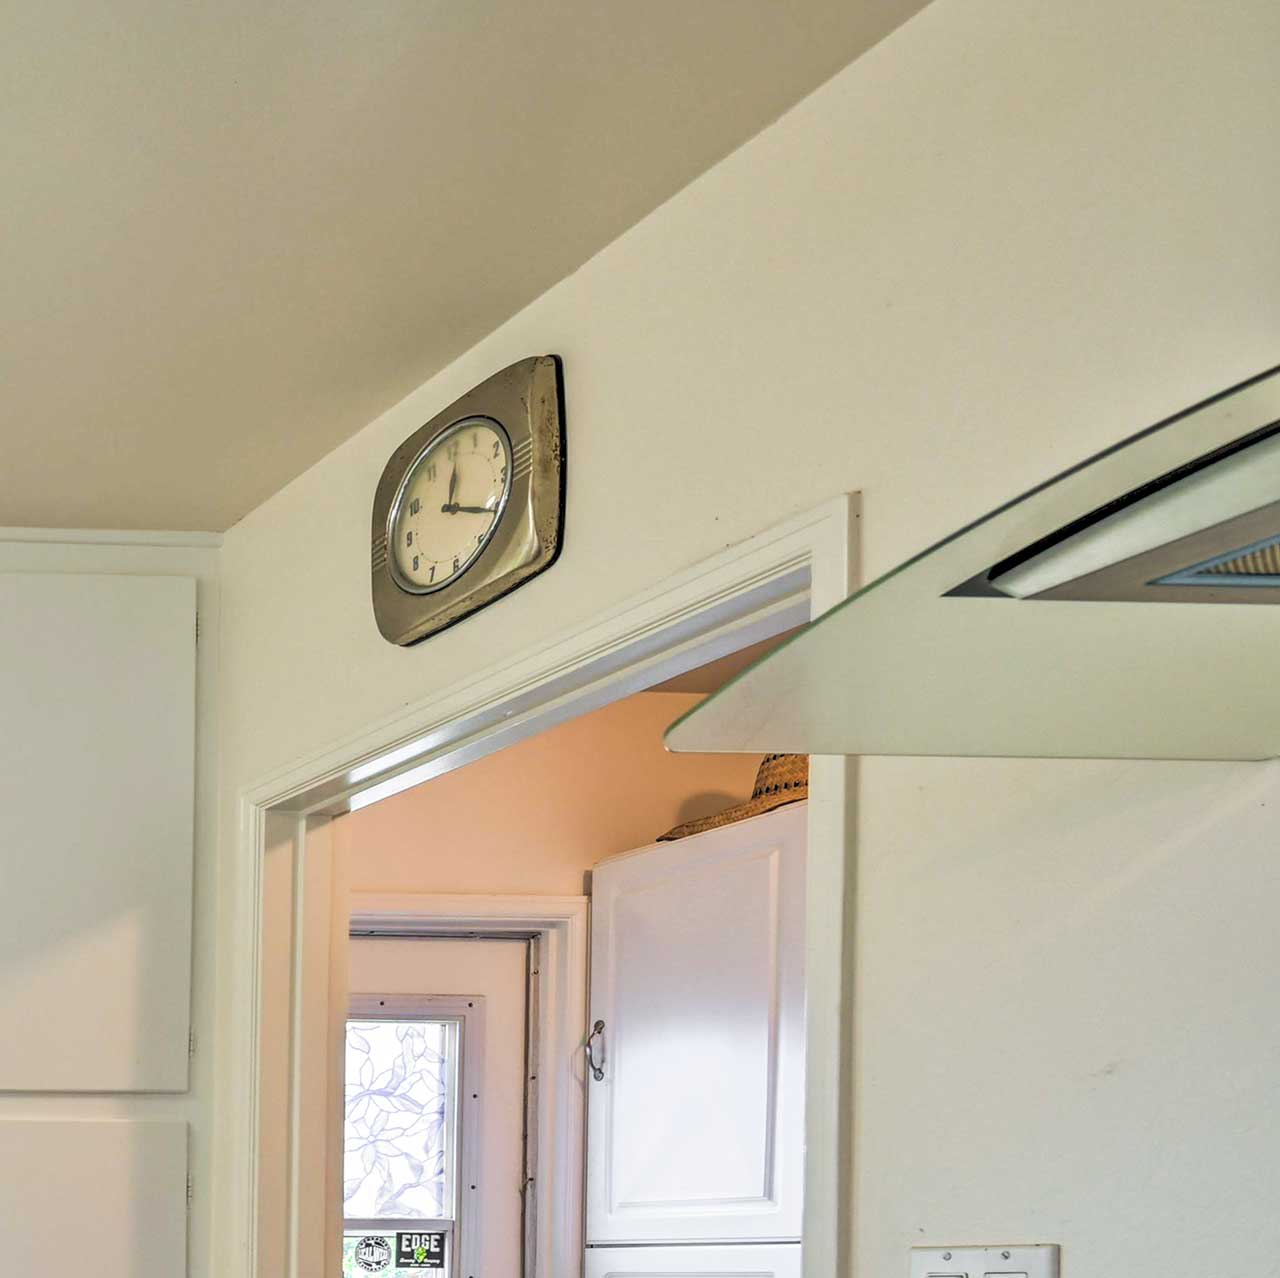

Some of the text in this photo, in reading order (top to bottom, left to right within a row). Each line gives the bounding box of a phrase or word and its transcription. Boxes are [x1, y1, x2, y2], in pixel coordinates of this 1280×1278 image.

[493, 440, 500, 459] 2
[410, 499, 419, 517] 10
[406, 531, 413, 548] 9
[413, 555, 419, 572] 8
[453, 557, 460, 574] 6
[429, 565, 436, 583] 7
[401, 1234, 440, 1252] EDGE
